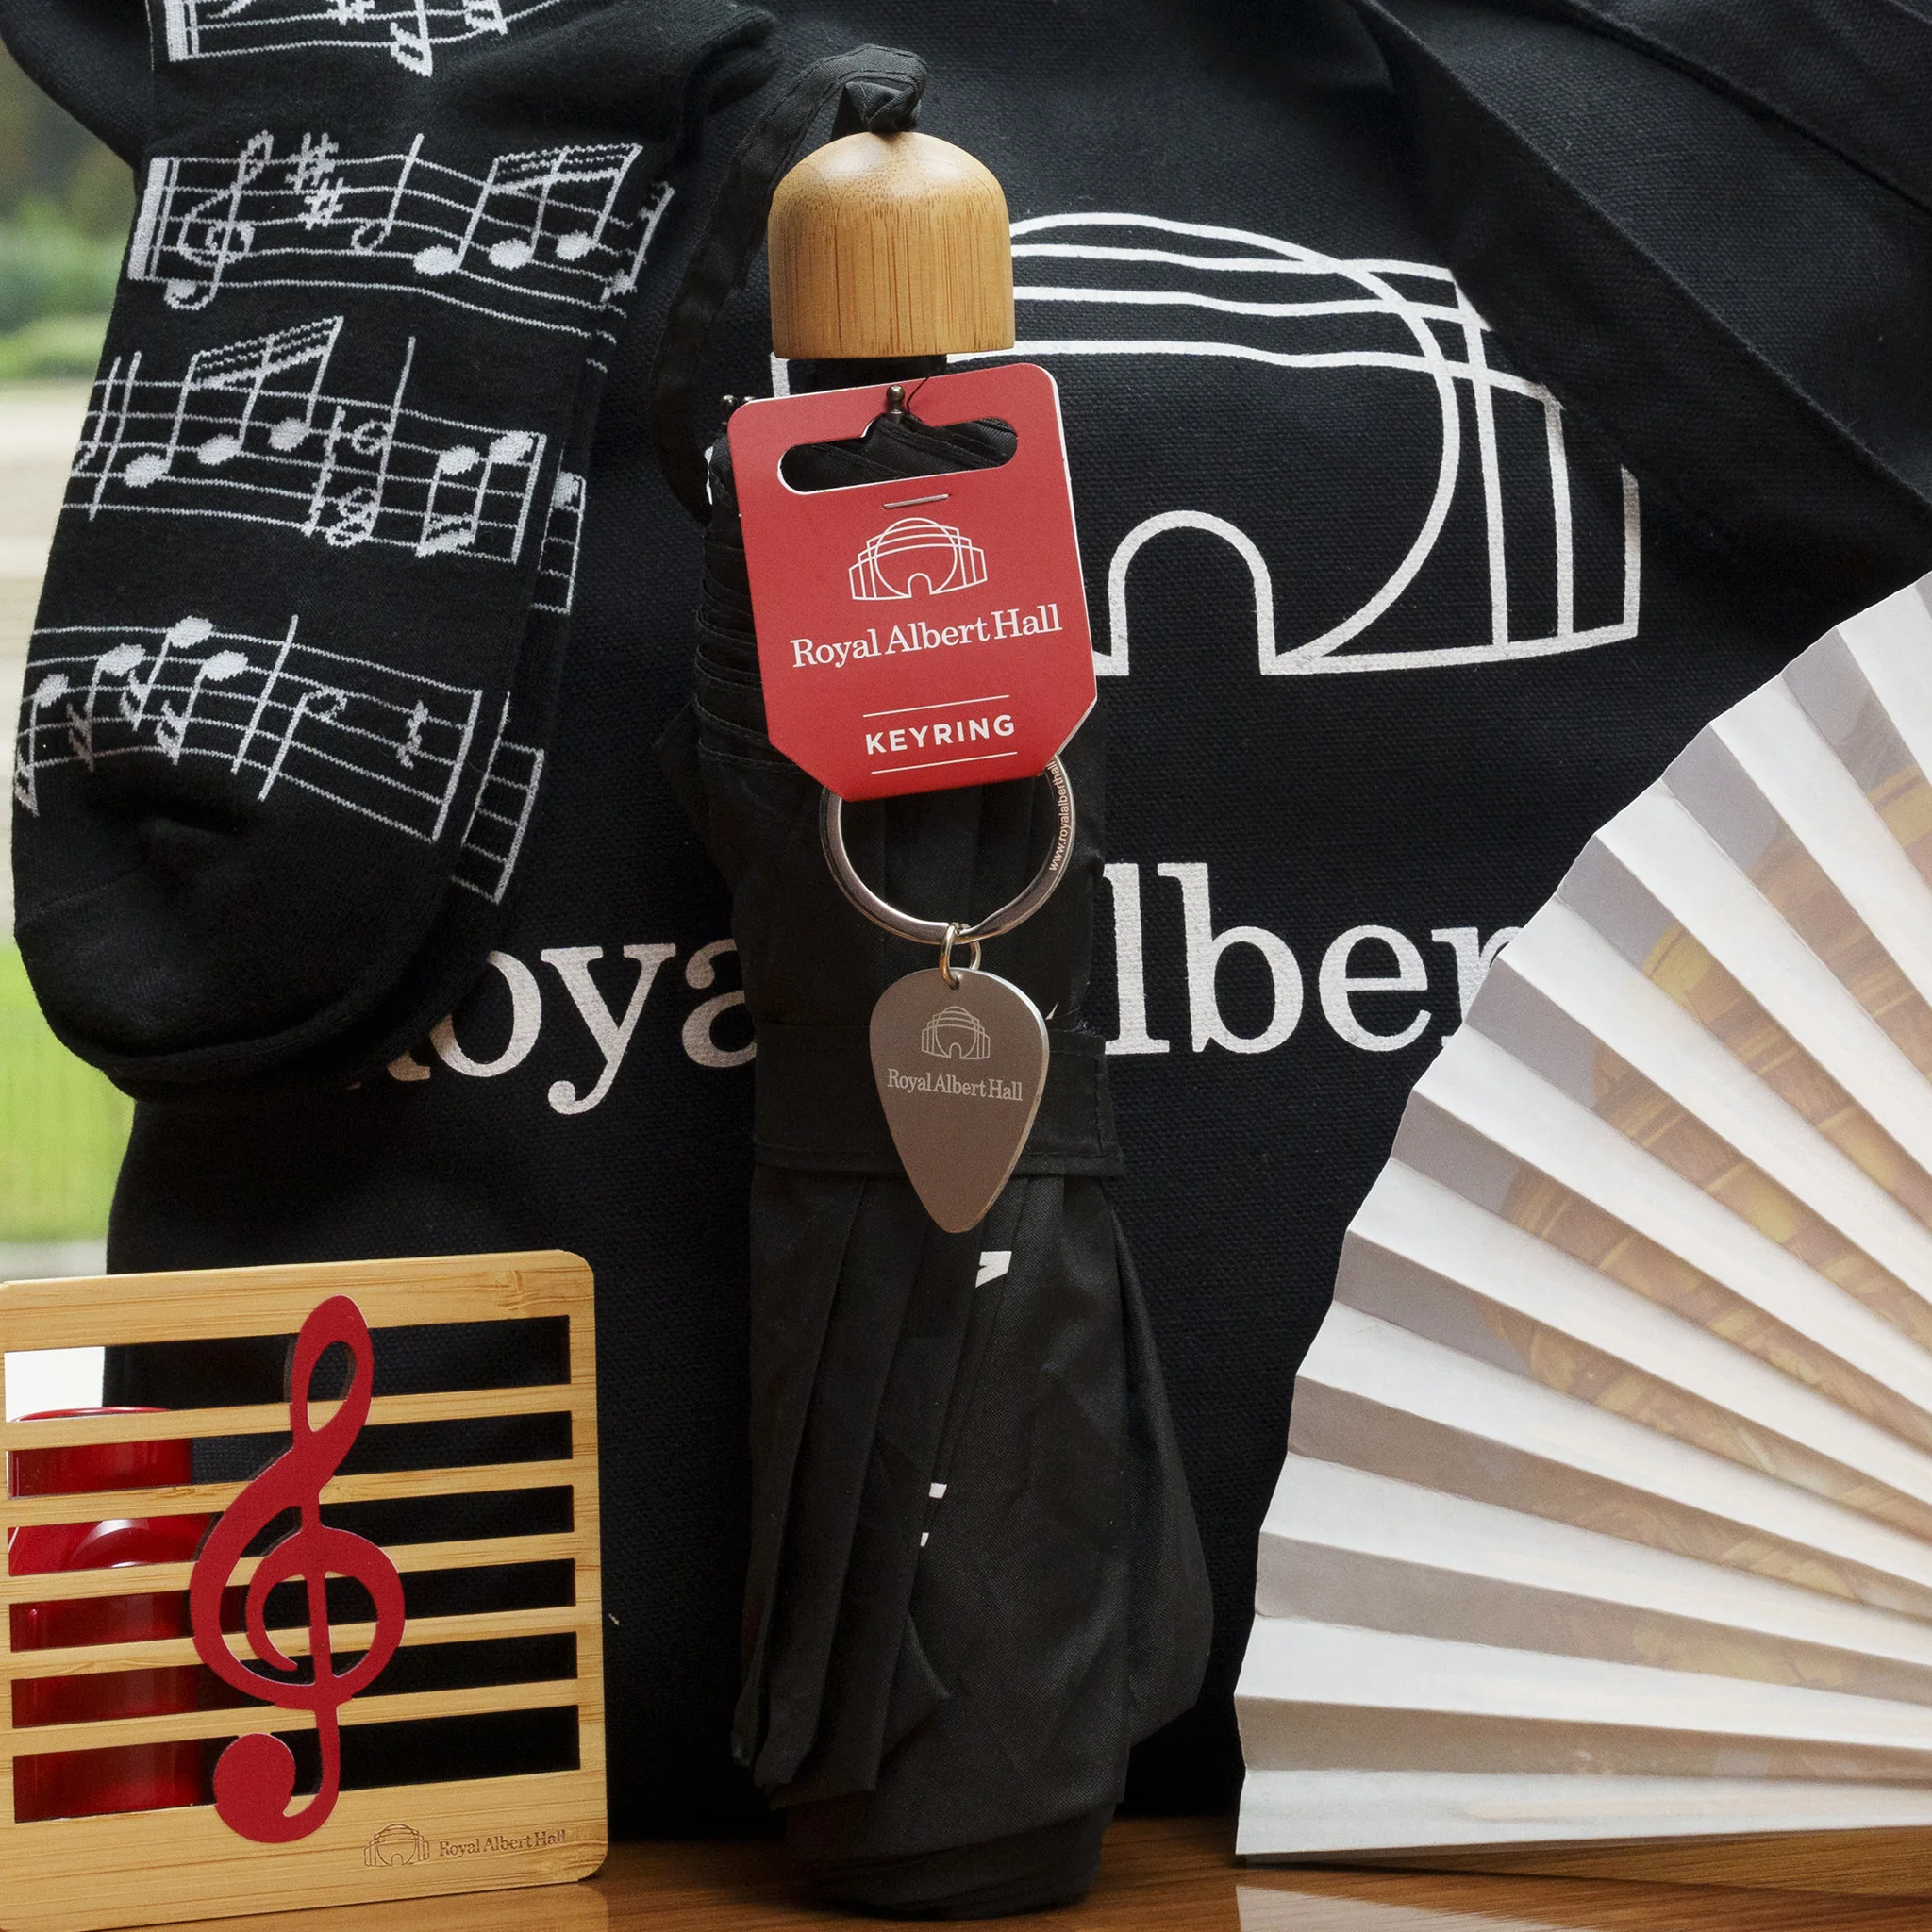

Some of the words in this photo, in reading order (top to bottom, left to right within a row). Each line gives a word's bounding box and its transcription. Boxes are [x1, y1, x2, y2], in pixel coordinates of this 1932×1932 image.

[790, 628, 882, 669] Royal
[885, 616, 991, 655] Albert
[991, 603, 1063, 640] Hall
[865, 714, 1015, 756] KEYRING
[387, 938, 758, 1116] oya
[1102, 861, 1524, 1056] lber
[887, 1068, 932, 1093] Royal
[932, 1074, 987, 1098] Albert
[988, 1078, 1024, 1102] Hall
[438, 1839, 481, 1857] Royal
[482, 1834, 533, 1853] Albert
[533, 1829, 567, 1847] Hall
